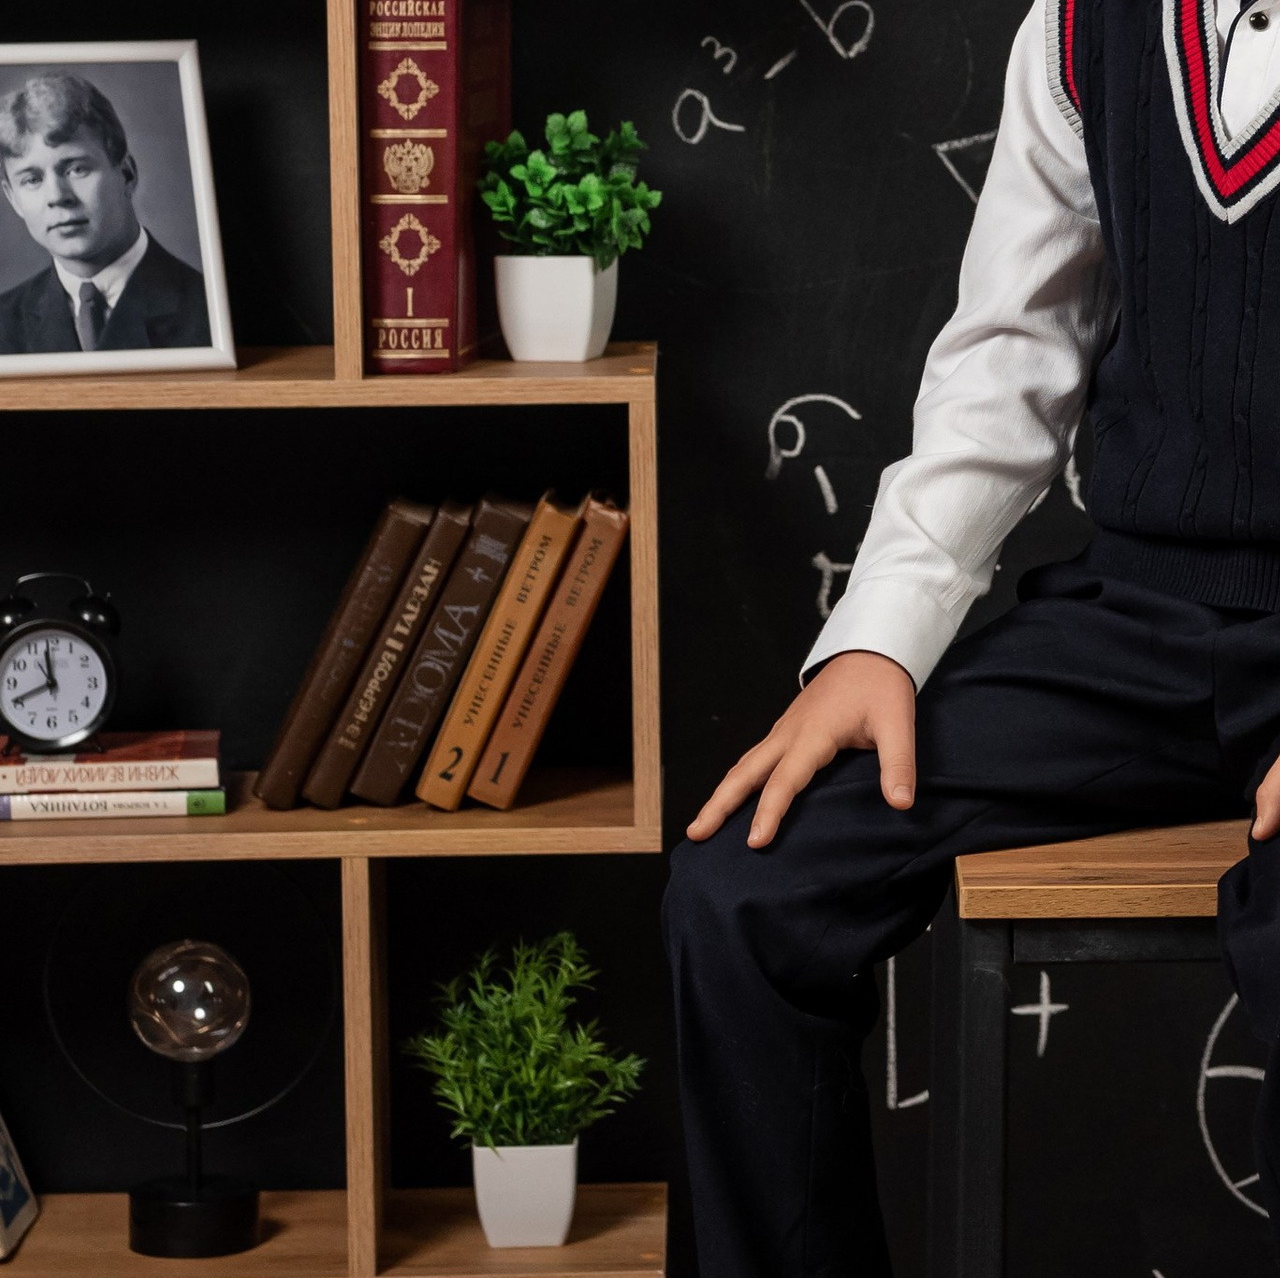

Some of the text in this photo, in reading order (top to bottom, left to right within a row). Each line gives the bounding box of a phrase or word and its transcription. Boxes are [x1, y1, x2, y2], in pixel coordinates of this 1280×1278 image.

[369, 0, 445, 16] РОССИЙСКАЯ
[369, 21, 445, 38] ЭНЦИКЛОПЕДИЯ
[379, 328, 444, 349] РОССИЯ
[394, 558, 442, 639] ТАРЗАН
[463, 534, 553, 726] УНЕСЕННЫЕ ВЕТРОМ
[512, 537, 603, 729] УНЕСЕННЫЕ ВЕТРОМ
[16, 765, 179, 786] ЖИЗНИ ВЕЛИКИХ ЛЮДЕЙ
[439, 746, 463, 782] 2
[489, 751, 510, 785] 1
[30, 800, 107, 813] БОТАНИКА
